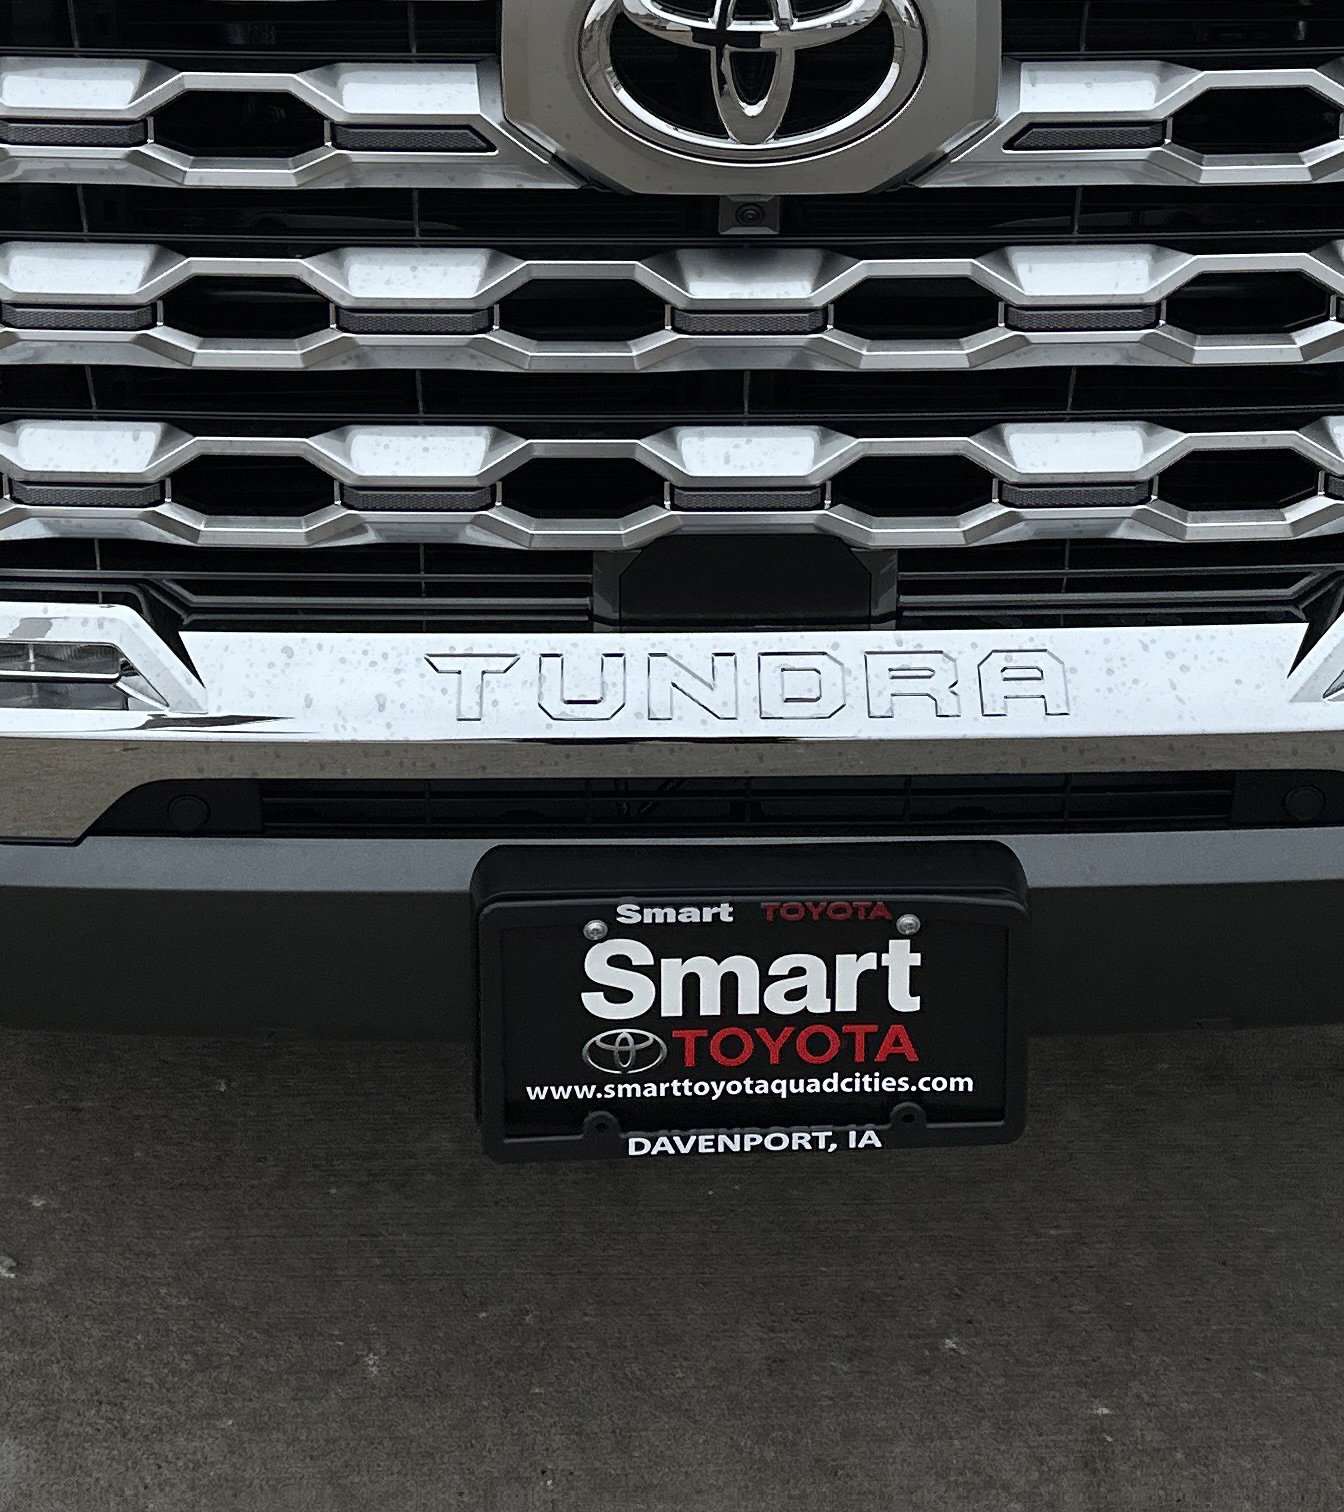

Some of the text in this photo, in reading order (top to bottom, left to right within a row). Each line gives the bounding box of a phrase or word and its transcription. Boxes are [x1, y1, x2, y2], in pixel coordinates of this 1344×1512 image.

[423, 648, 1071, 722] TUNDRA
[616, 901, 893, 925] Smart TOYOTA
[580, 937, 922, 1021] Smart
[672, 1023, 919, 1068] TOYOTA
[525, 1071, 975, 1102] www.smarttoyotaquadcities.com
[627, 1129, 883, 1156] DAVENPORT, IA
